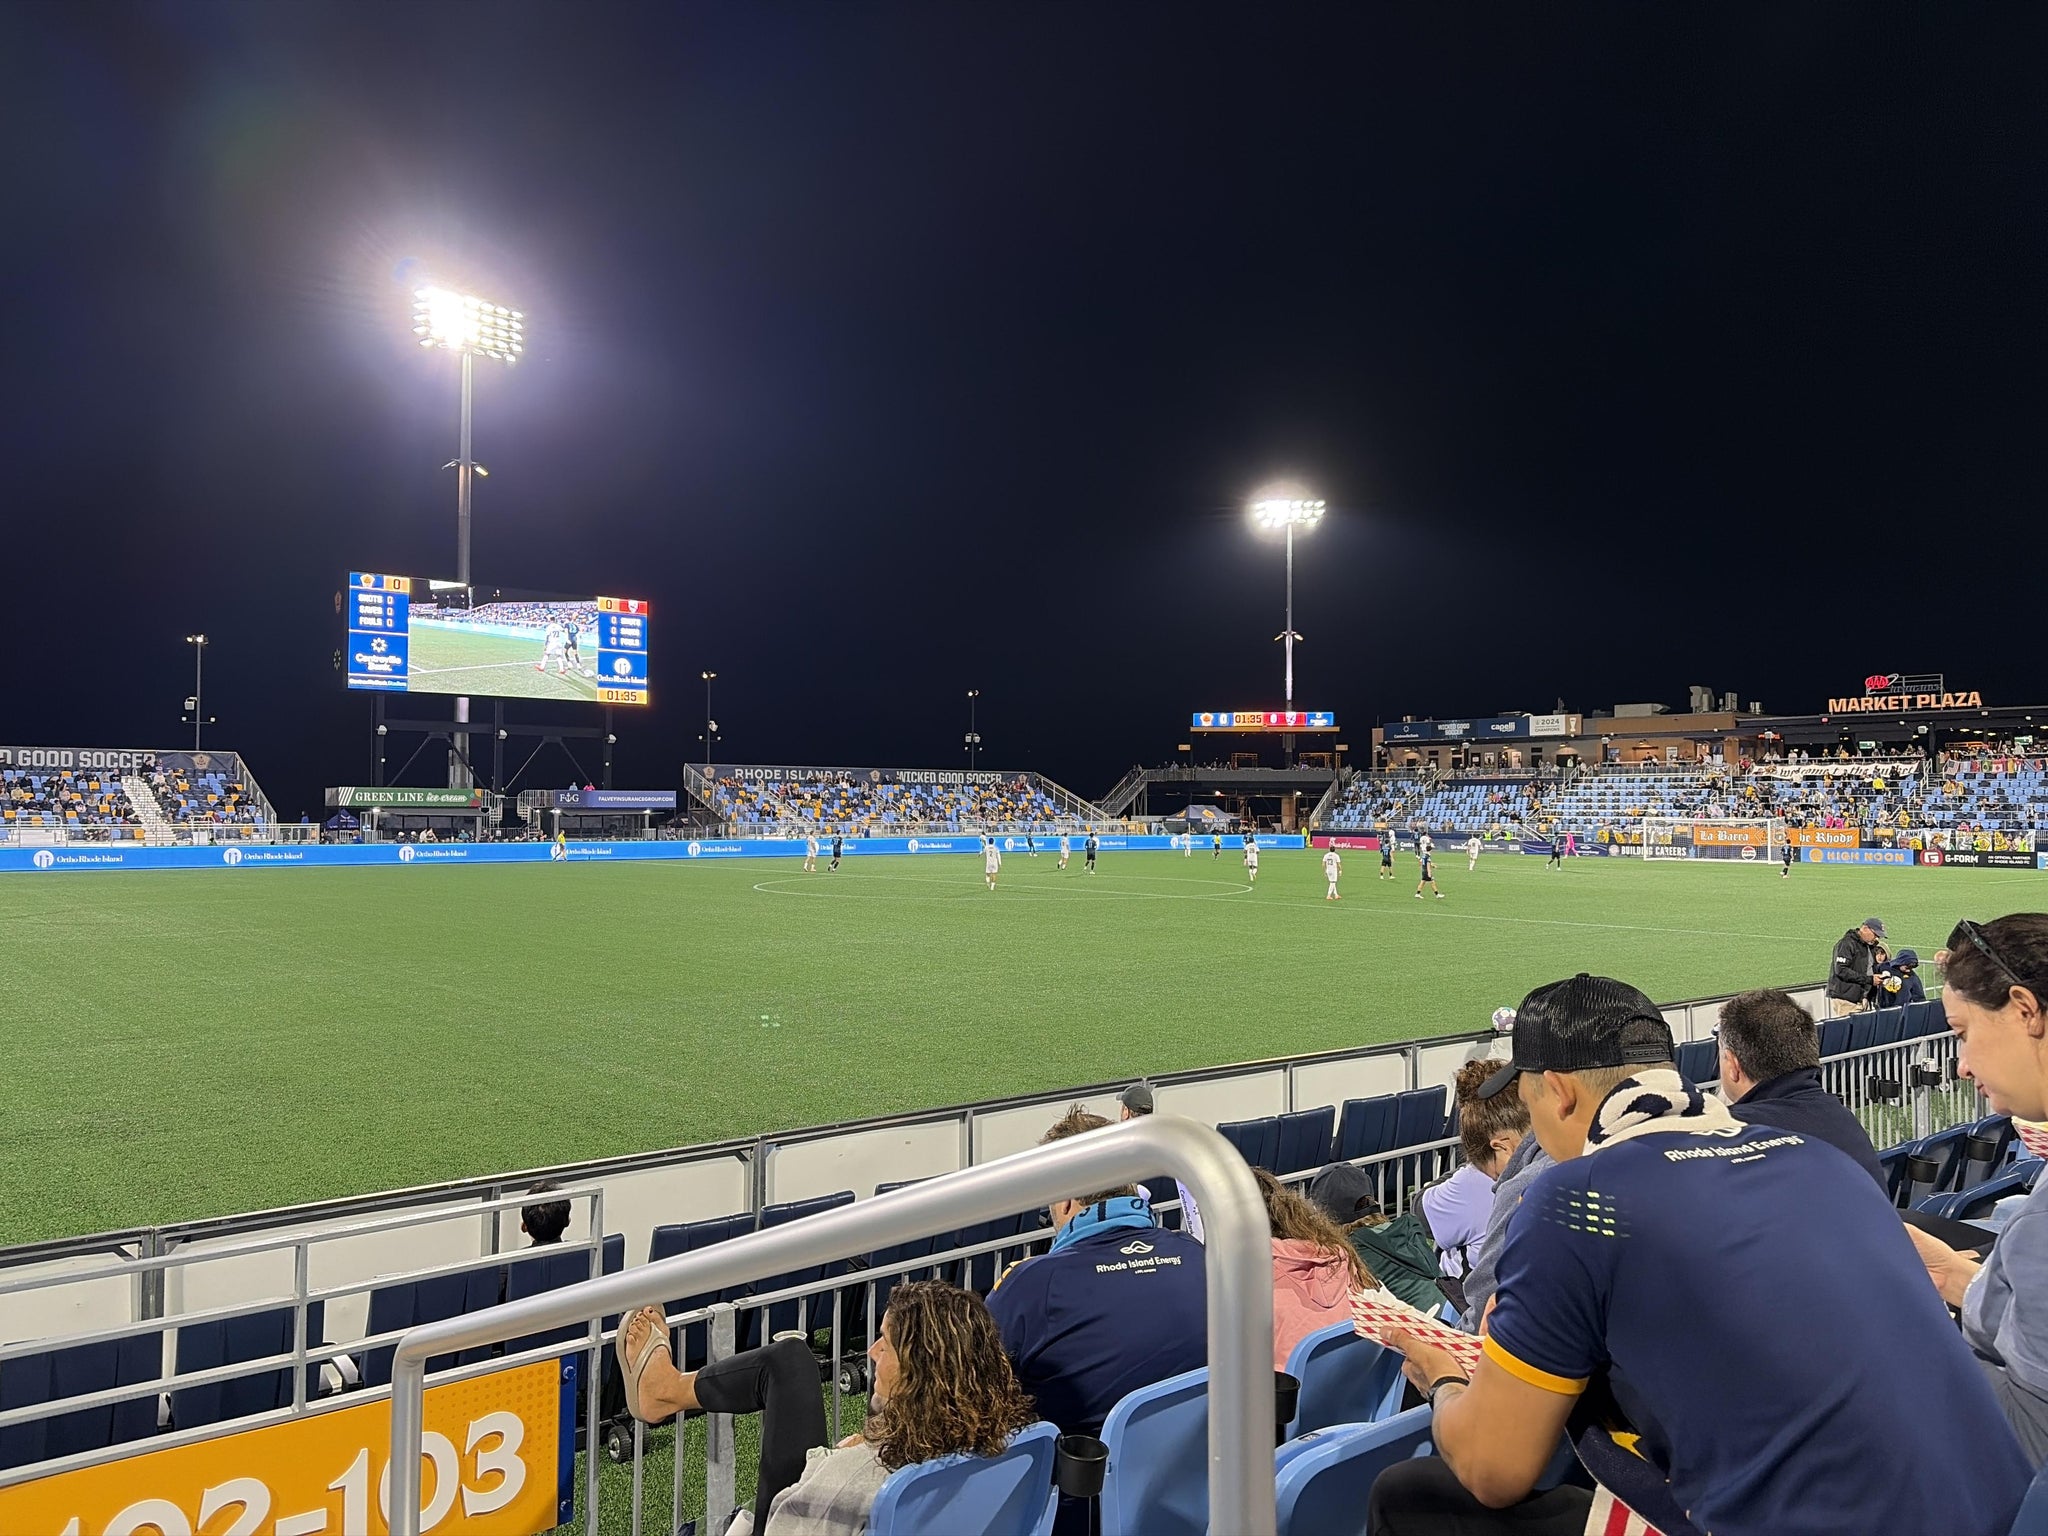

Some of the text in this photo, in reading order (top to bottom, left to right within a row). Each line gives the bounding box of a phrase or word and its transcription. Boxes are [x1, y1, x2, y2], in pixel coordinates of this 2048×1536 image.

[394, 579, 400, 589] 0
[605, 600, 612, 610] 0
[607, 690, 637, 702] 01:35
[1828, 691, 1983, 713] MARKET PLAZA
[1235, 714, 1262, 724] 01:35
[18, 750, 73, 767] GOOD
[734, 768, 781, 780] RHODE
[896, 771, 936, 783] WICKED
[938, 772, 964, 783] GOOD
[355, 791, 395, 802] GREEN
[397, 792, 424, 802] LINE
[1699, 830, 1713, 841] La
[1718, 830, 1749, 841] Barra
[1816, 832, 1853, 845] Rhody
[244, 852, 303, 860] Ortho Rhode Island
[1655, 846, 1687, 856] CAREERS
[1827, 851, 1905, 862] HIGH NOON
[56, 855, 123, 863] Ortho Rhode Island
[1945, 855, 1979, 863] G-FORM
[1664, 1147, 1714, 1162] Rhode
[1710, 1144, 1755, 1157] Island
[1749, 1135, 1805, 1150] Energy
[1096, 1262, 1127, 1273] Rhode
[1128, 1257, 1155, 1268] Island
[1154, 1255, 1181, 1265] Energy
[60, 1411, 526, 1536] 2-103
